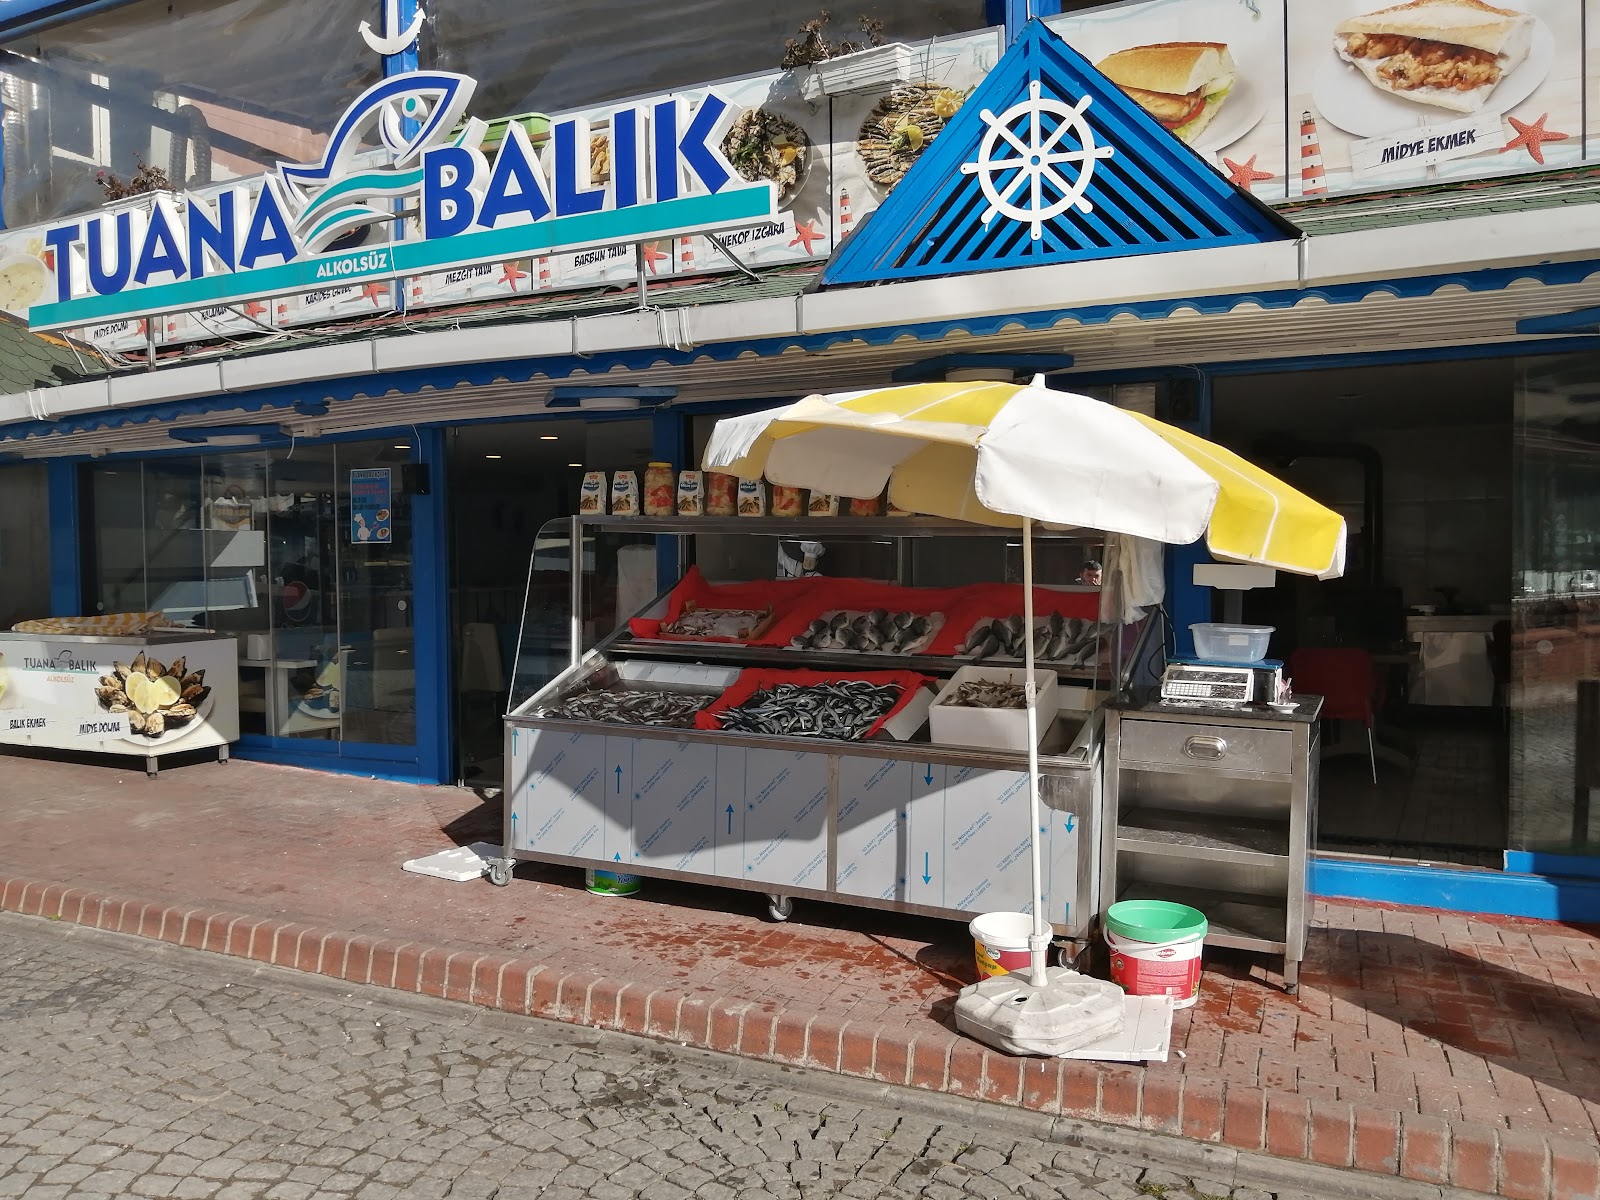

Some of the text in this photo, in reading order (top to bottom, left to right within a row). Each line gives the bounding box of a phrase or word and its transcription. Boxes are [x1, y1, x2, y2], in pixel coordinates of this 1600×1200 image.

[1381, 129, 1476, 163] MİDYE EKMEK
[45, 92, 731, 302] TUANA BALIK
[752, 222, 785, 241] IZGARA
[608, 246, 626, 258] TAVA
[316, 251, 387, 278] ALKOLSÜZ
[24, 657, 97, 671] TUANA BALIK
[9, 718, 46, 730] BALIK EKMEK
[98, 722, 120, 733] DOLMA
